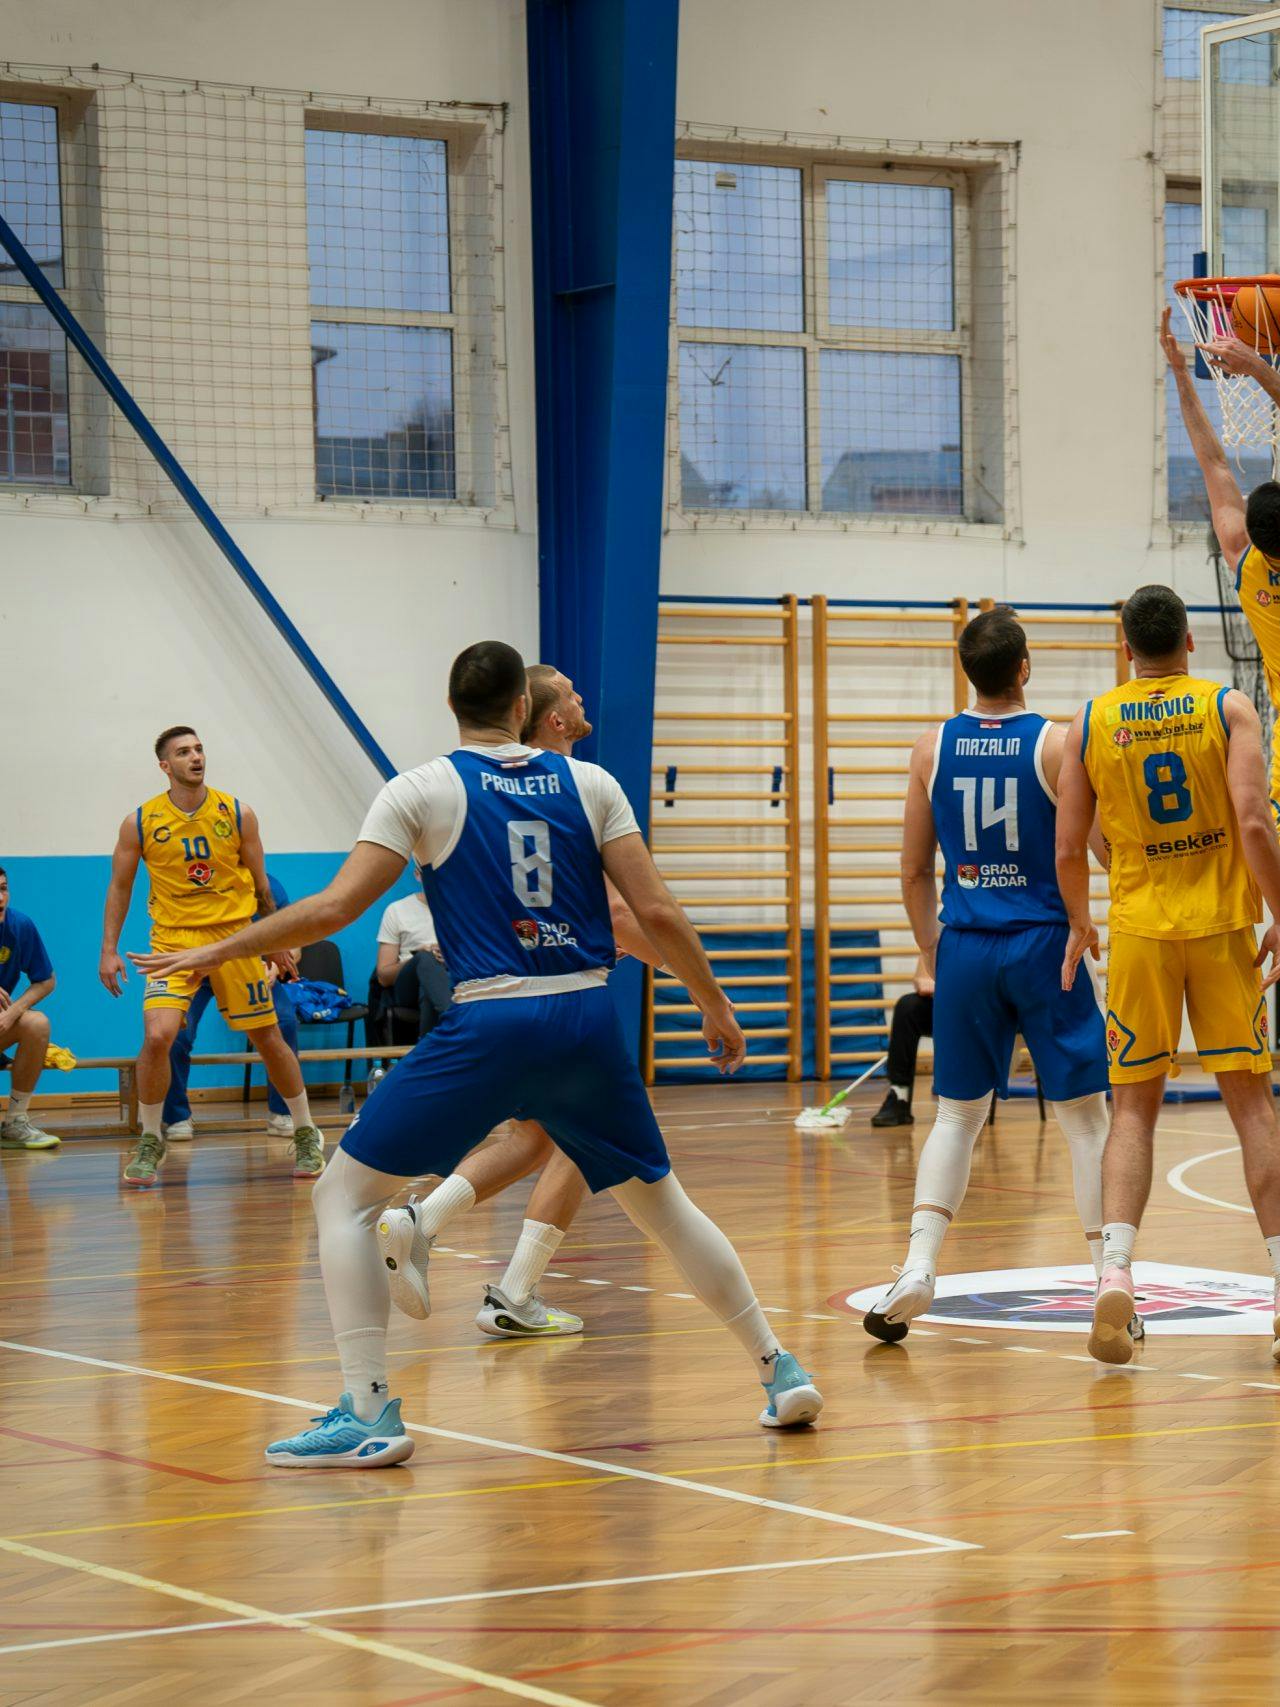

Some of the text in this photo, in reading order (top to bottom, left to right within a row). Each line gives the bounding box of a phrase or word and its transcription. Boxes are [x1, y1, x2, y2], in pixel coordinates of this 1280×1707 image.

[1120, 693, 1195, 722] MIKOVIĆ
[955, 737, 1021, 756] MAZALIN
[480, 771, 561, 796] PROLETA
[1143, 751, 1194, 825] 8
[953, 777, 1020, 852] 14
[181, 836, 211, 862] 10
[1143, 831, 1226, 857] sseker
[507, 820, 554, 908] 8
[980, 864, 1019, 876] GRAD
[981, 876, 1028, 888] ZADAR
[246, 980, 270, 1006] 10
